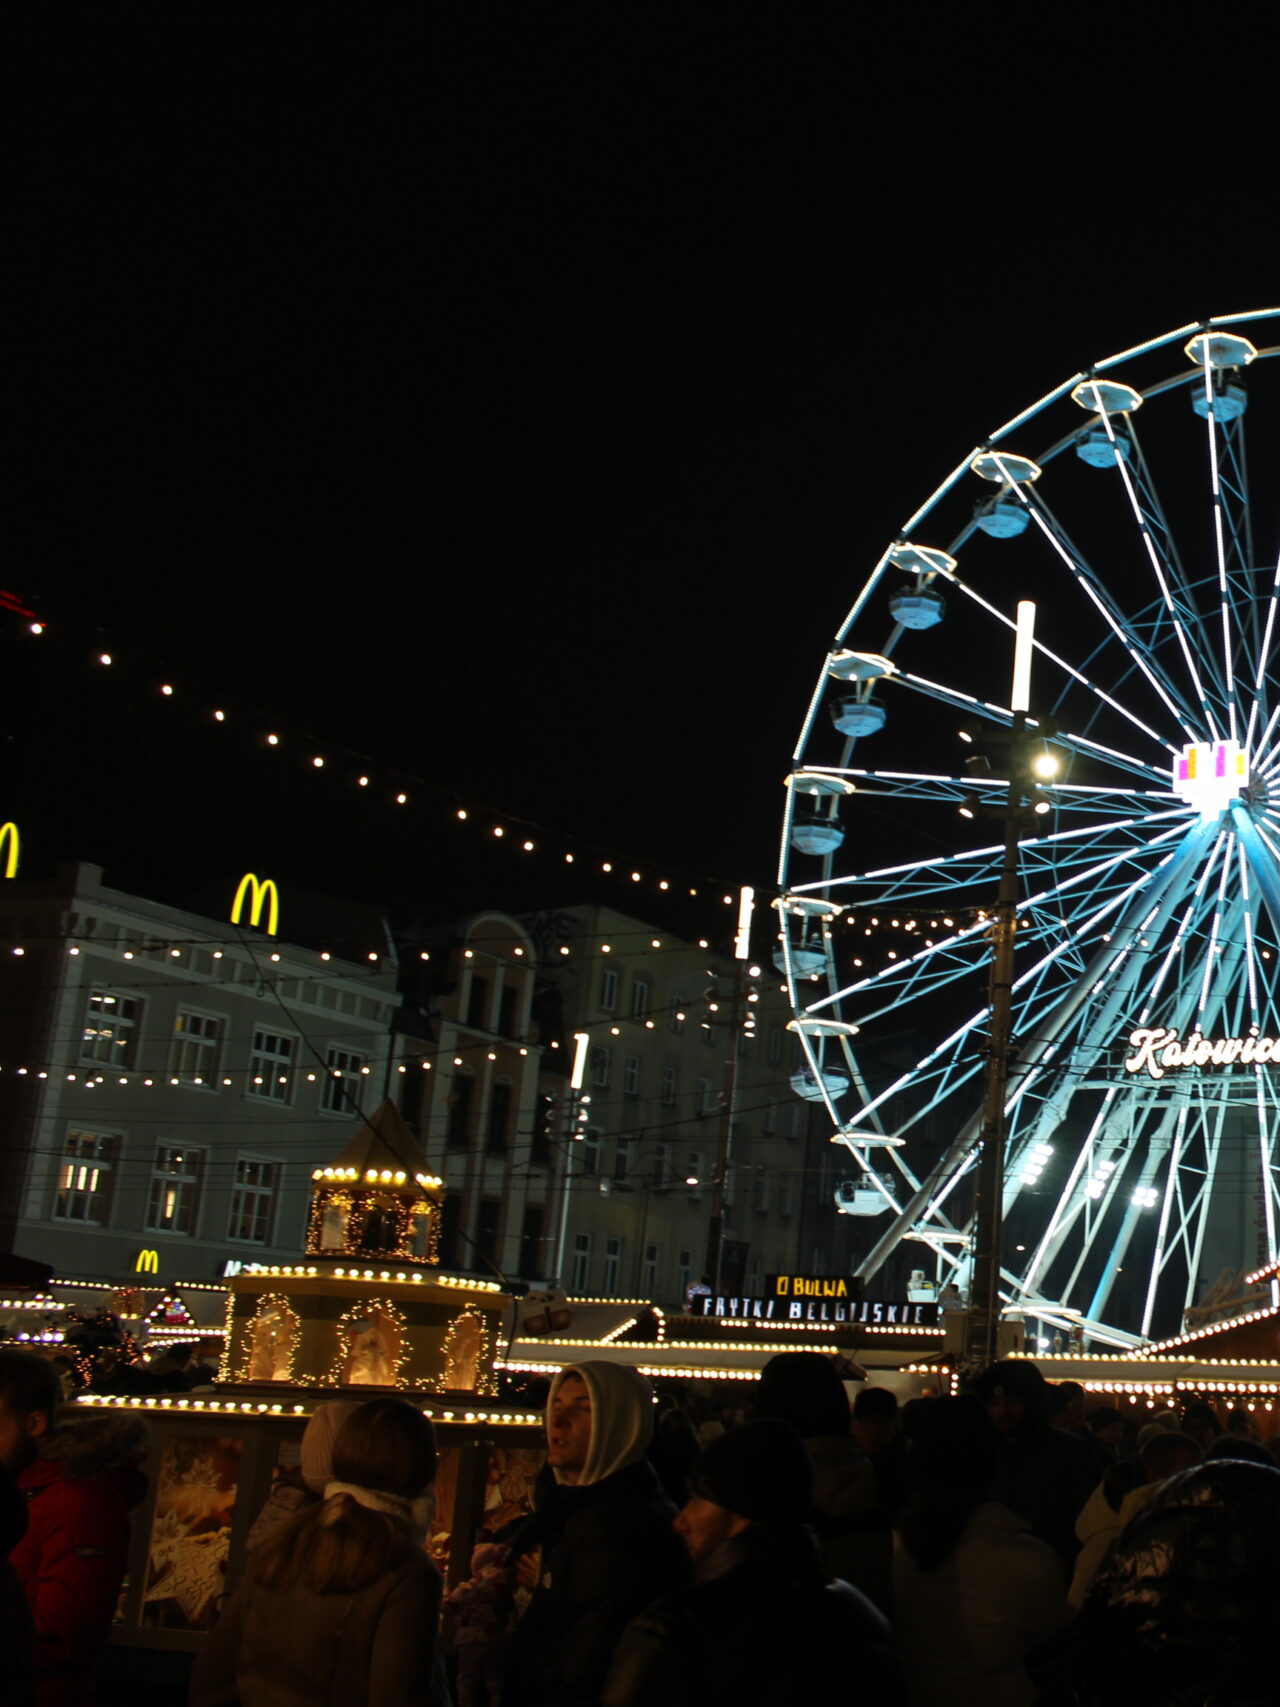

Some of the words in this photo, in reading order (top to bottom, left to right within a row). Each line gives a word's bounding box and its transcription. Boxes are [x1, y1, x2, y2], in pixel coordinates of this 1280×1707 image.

[793, 1278, 847, 1297] BULWA
[703, 1297, 774, 1319] FRYTKI
[789, 1302, 924, 1324] BELGIJSKIE
